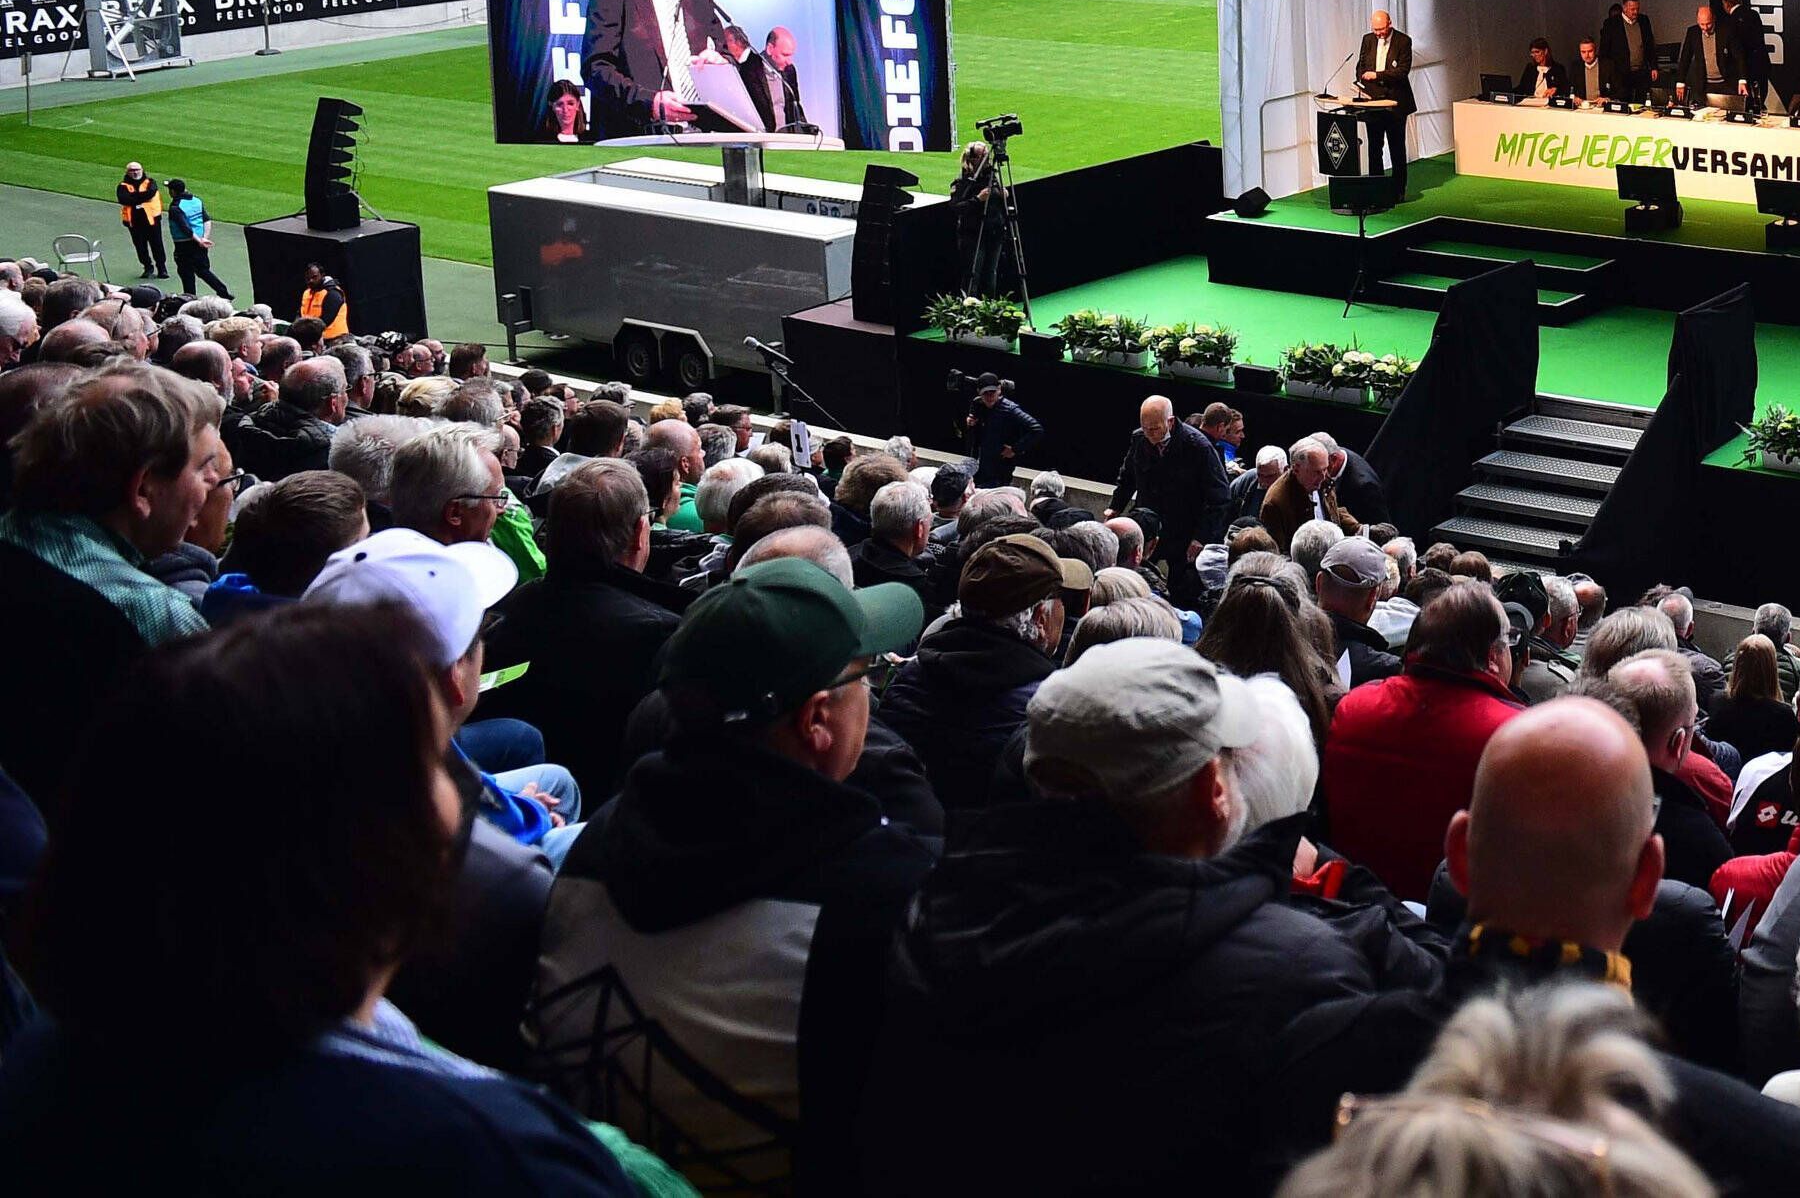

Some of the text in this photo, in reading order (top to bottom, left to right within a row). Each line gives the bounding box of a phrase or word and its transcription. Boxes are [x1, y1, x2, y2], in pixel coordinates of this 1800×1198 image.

[0, 5, 80, 35] RAX
[217, 9, 254, 21] FEEL
[34, 30, 82, 44] GOOD
